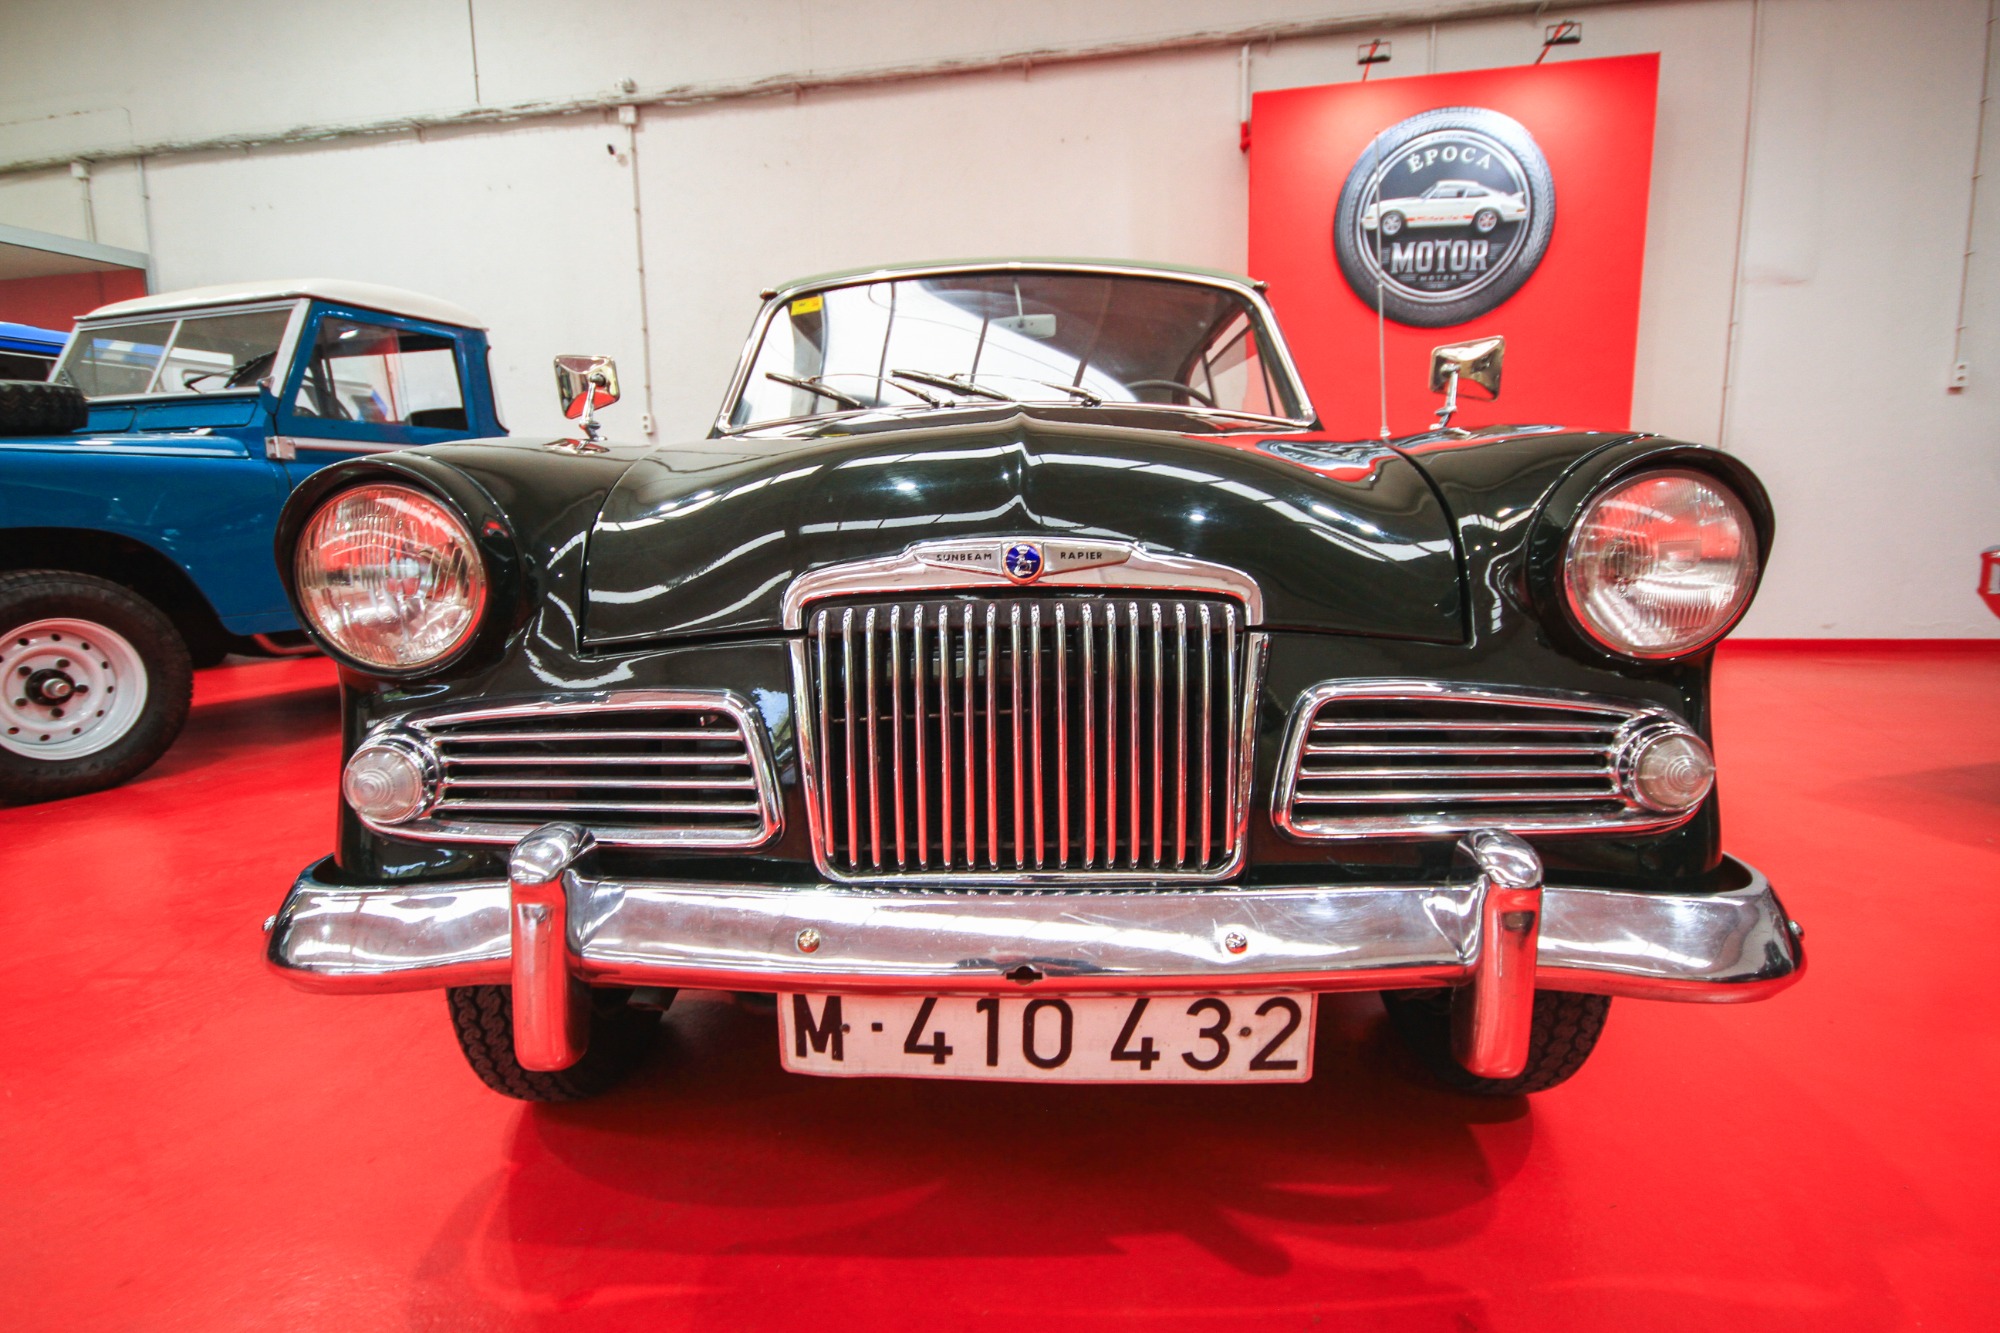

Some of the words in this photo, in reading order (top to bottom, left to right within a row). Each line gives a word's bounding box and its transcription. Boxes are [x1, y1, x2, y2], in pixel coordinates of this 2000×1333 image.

[1391, 238, 1489, 274] MOTOR
[936, 553, 992, 561] SUNBEAM
[1060, 551, 1103, 560] RAPIER
